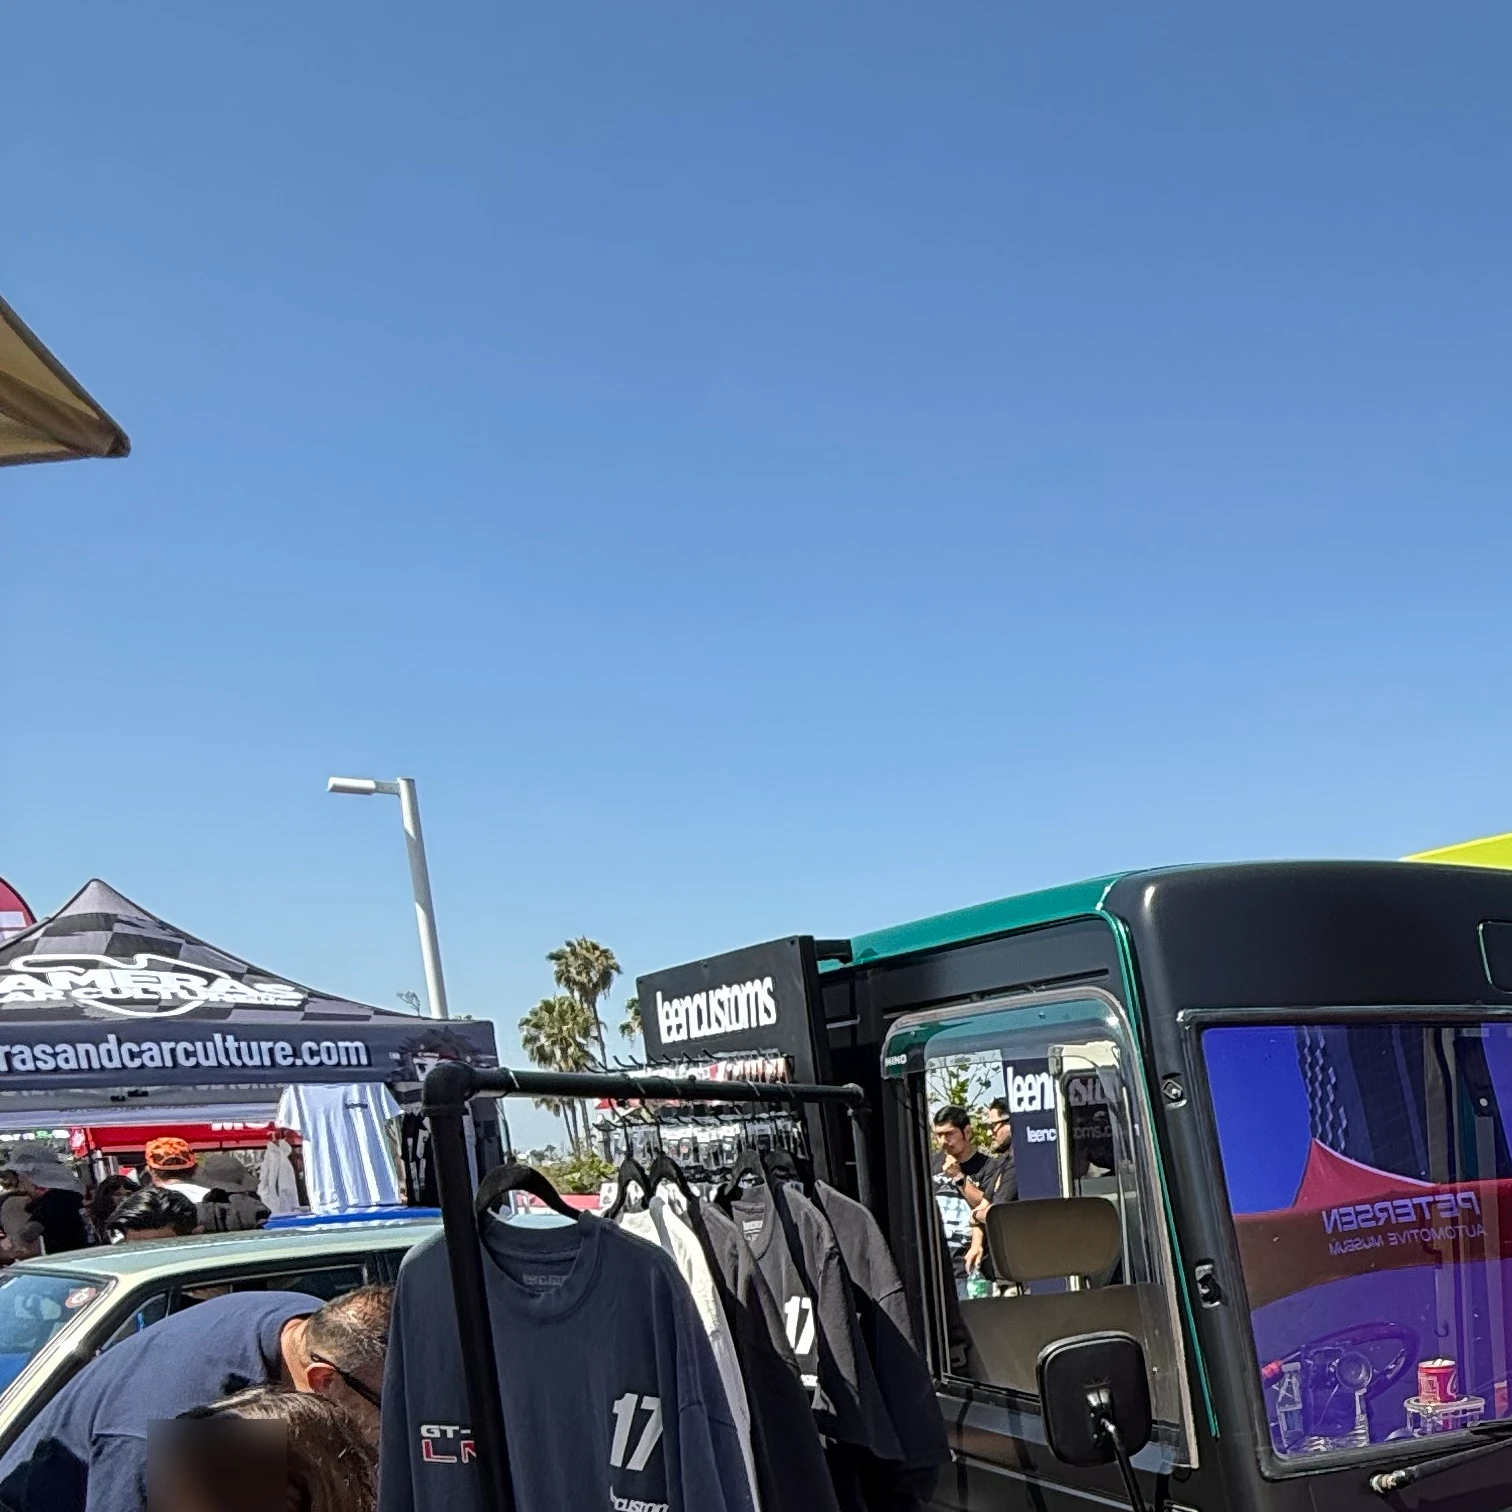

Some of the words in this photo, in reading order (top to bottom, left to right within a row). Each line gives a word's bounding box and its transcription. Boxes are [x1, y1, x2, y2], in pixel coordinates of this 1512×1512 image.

[656, 976, 777, 1044] leencustoms
[0, 1033, 368, 1072] rasandcarculture.com
[1006, 1066, 1055, 1113] leen
[785, 1296, 815, 1355] 17
[420, 1424, 471, 1439] GT-
[609, 1392, 664, 1472] 17
